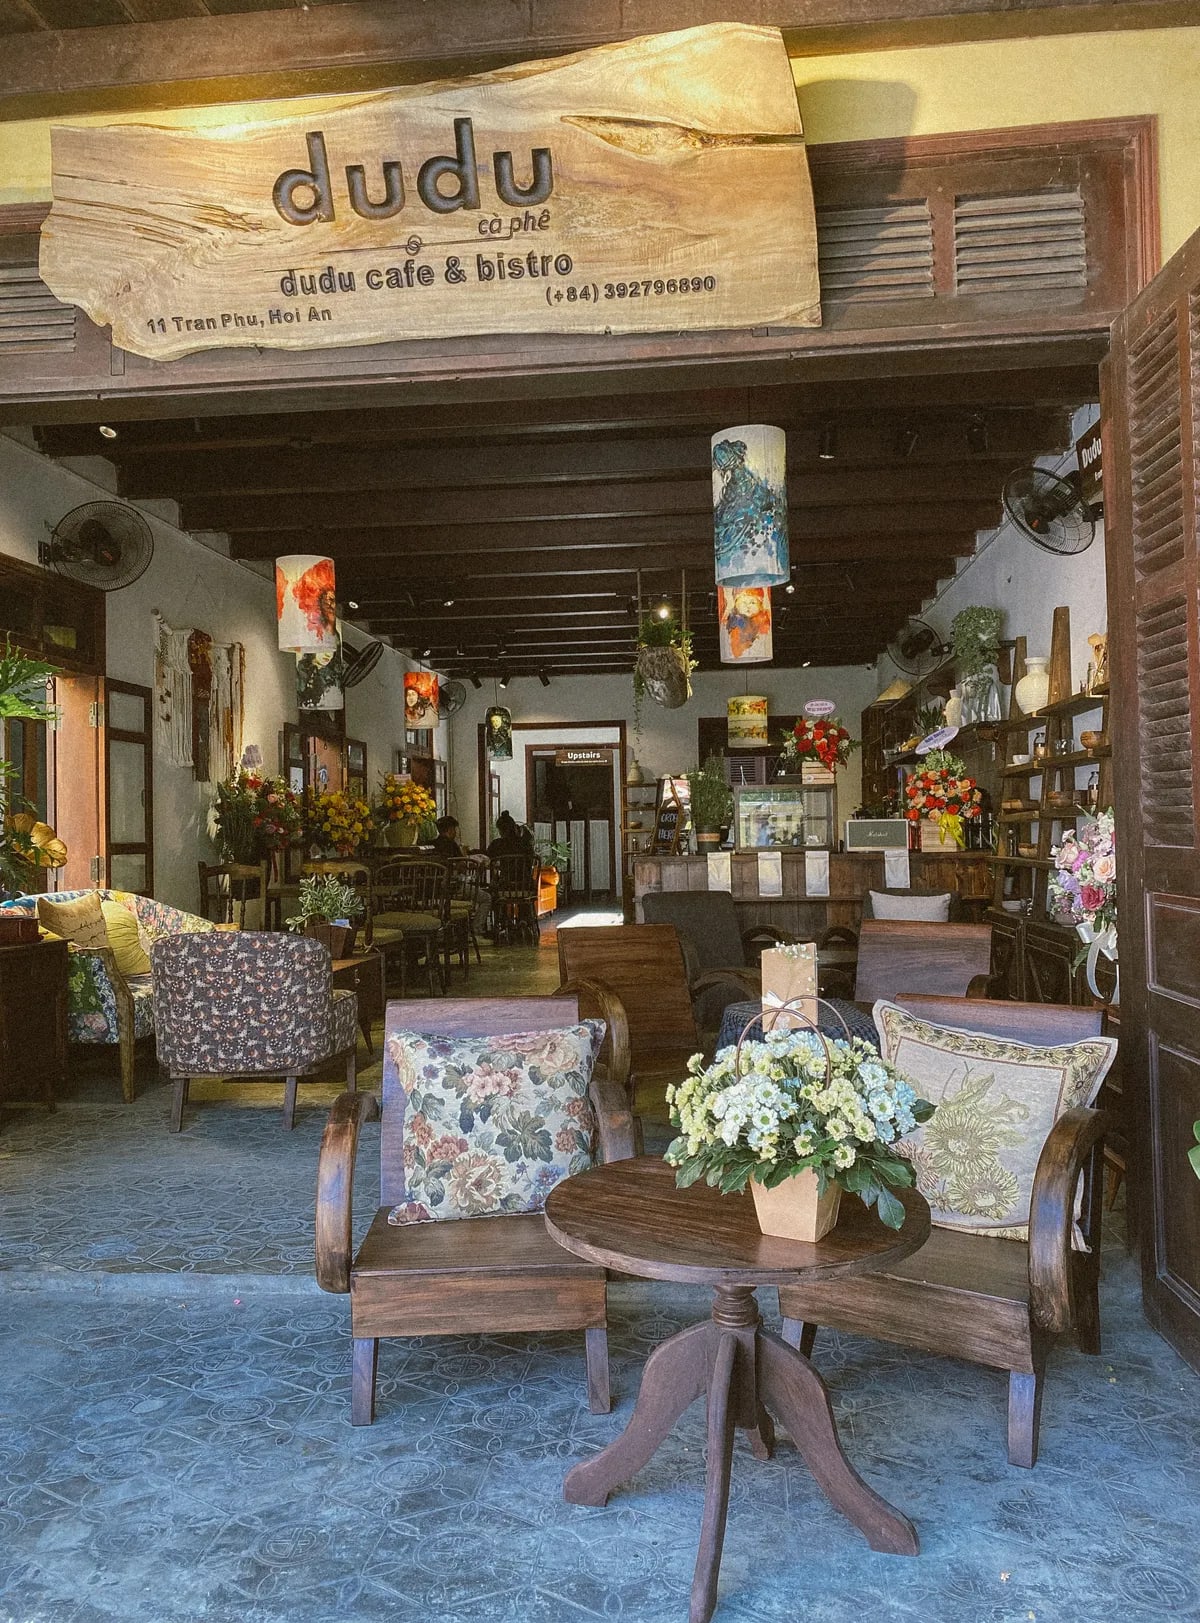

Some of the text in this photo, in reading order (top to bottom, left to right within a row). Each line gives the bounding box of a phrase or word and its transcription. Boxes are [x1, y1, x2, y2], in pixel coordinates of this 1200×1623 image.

[272, 117, 554, 226] dudu
[478, 208, 551, 239] cà phê
[280, 250, 573, 297] dudu cafe & bistro
[545, 275, 717, 306] (+84) 392796890
[147, 306, 333, 334] 11 Tran Phu, Hoi An
[567, 751, 601, 760] Upstairs
